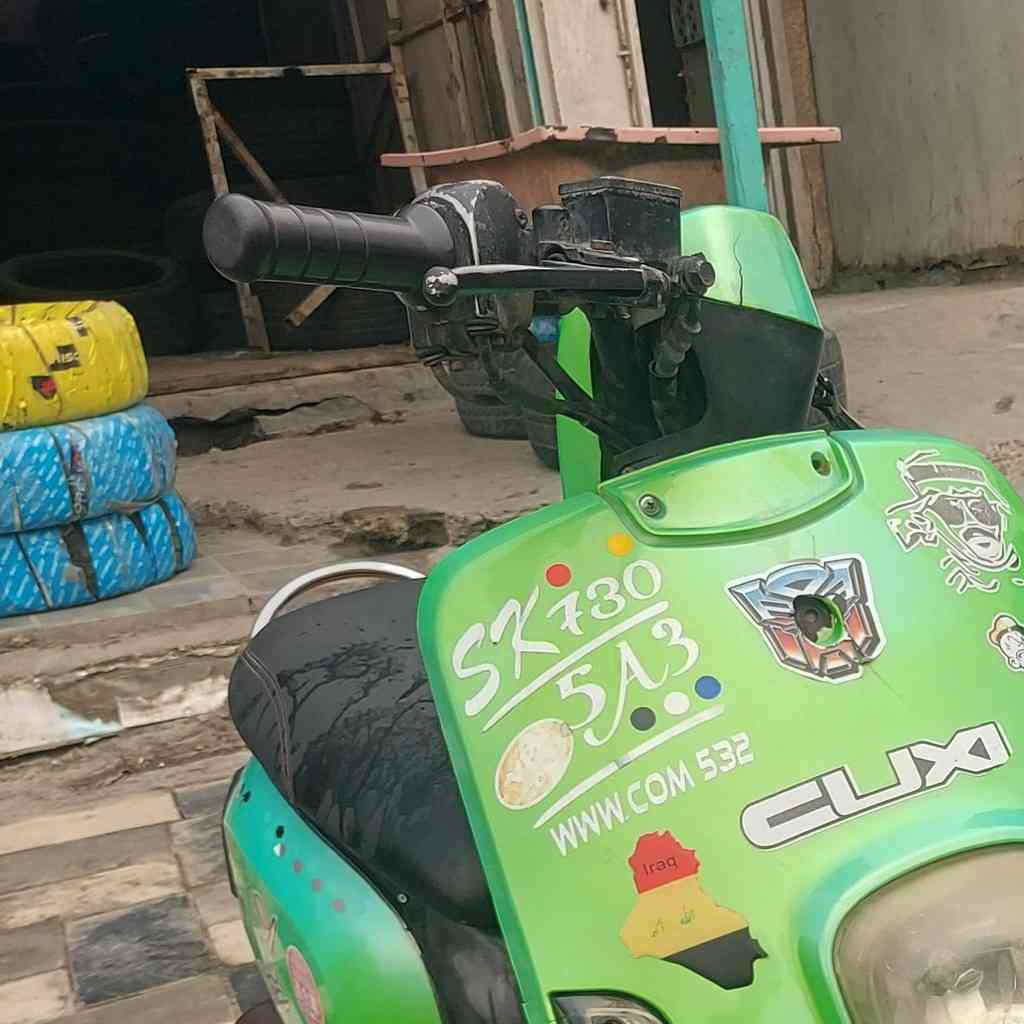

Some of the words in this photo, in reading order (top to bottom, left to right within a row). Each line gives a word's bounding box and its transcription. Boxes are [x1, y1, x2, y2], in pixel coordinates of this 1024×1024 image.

[550, 760, 696, 857] WWW.COM
[696, 731, 754, 782] 532
[740, 720, 1010, 851] CUXI
[642, 856, 679, 876] Iraq
